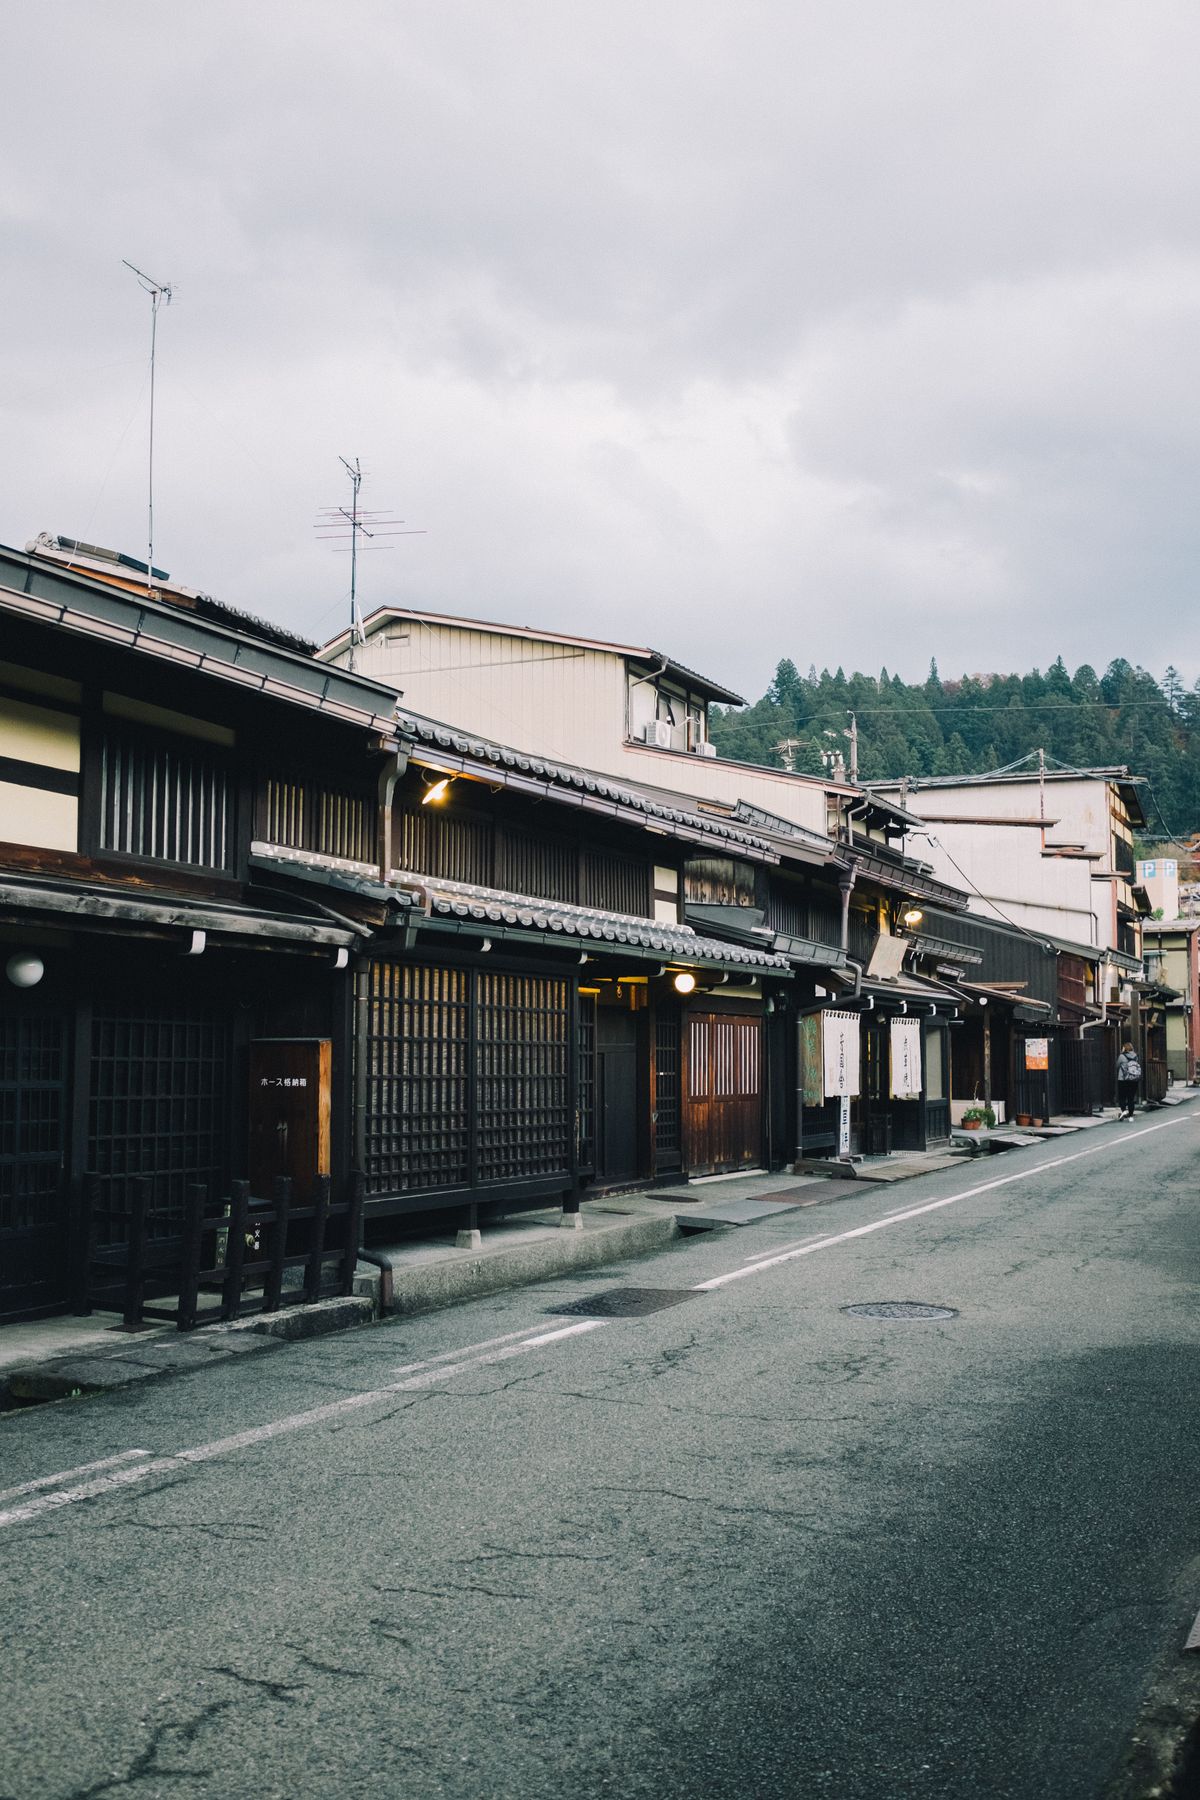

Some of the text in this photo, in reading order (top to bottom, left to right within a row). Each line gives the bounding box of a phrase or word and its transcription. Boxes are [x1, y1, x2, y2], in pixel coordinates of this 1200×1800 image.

[1145, 864, 1154, 878] P
[1166, 862, 1174, 877] P
[260, 1077, 307, 1087] ホース格納箱
